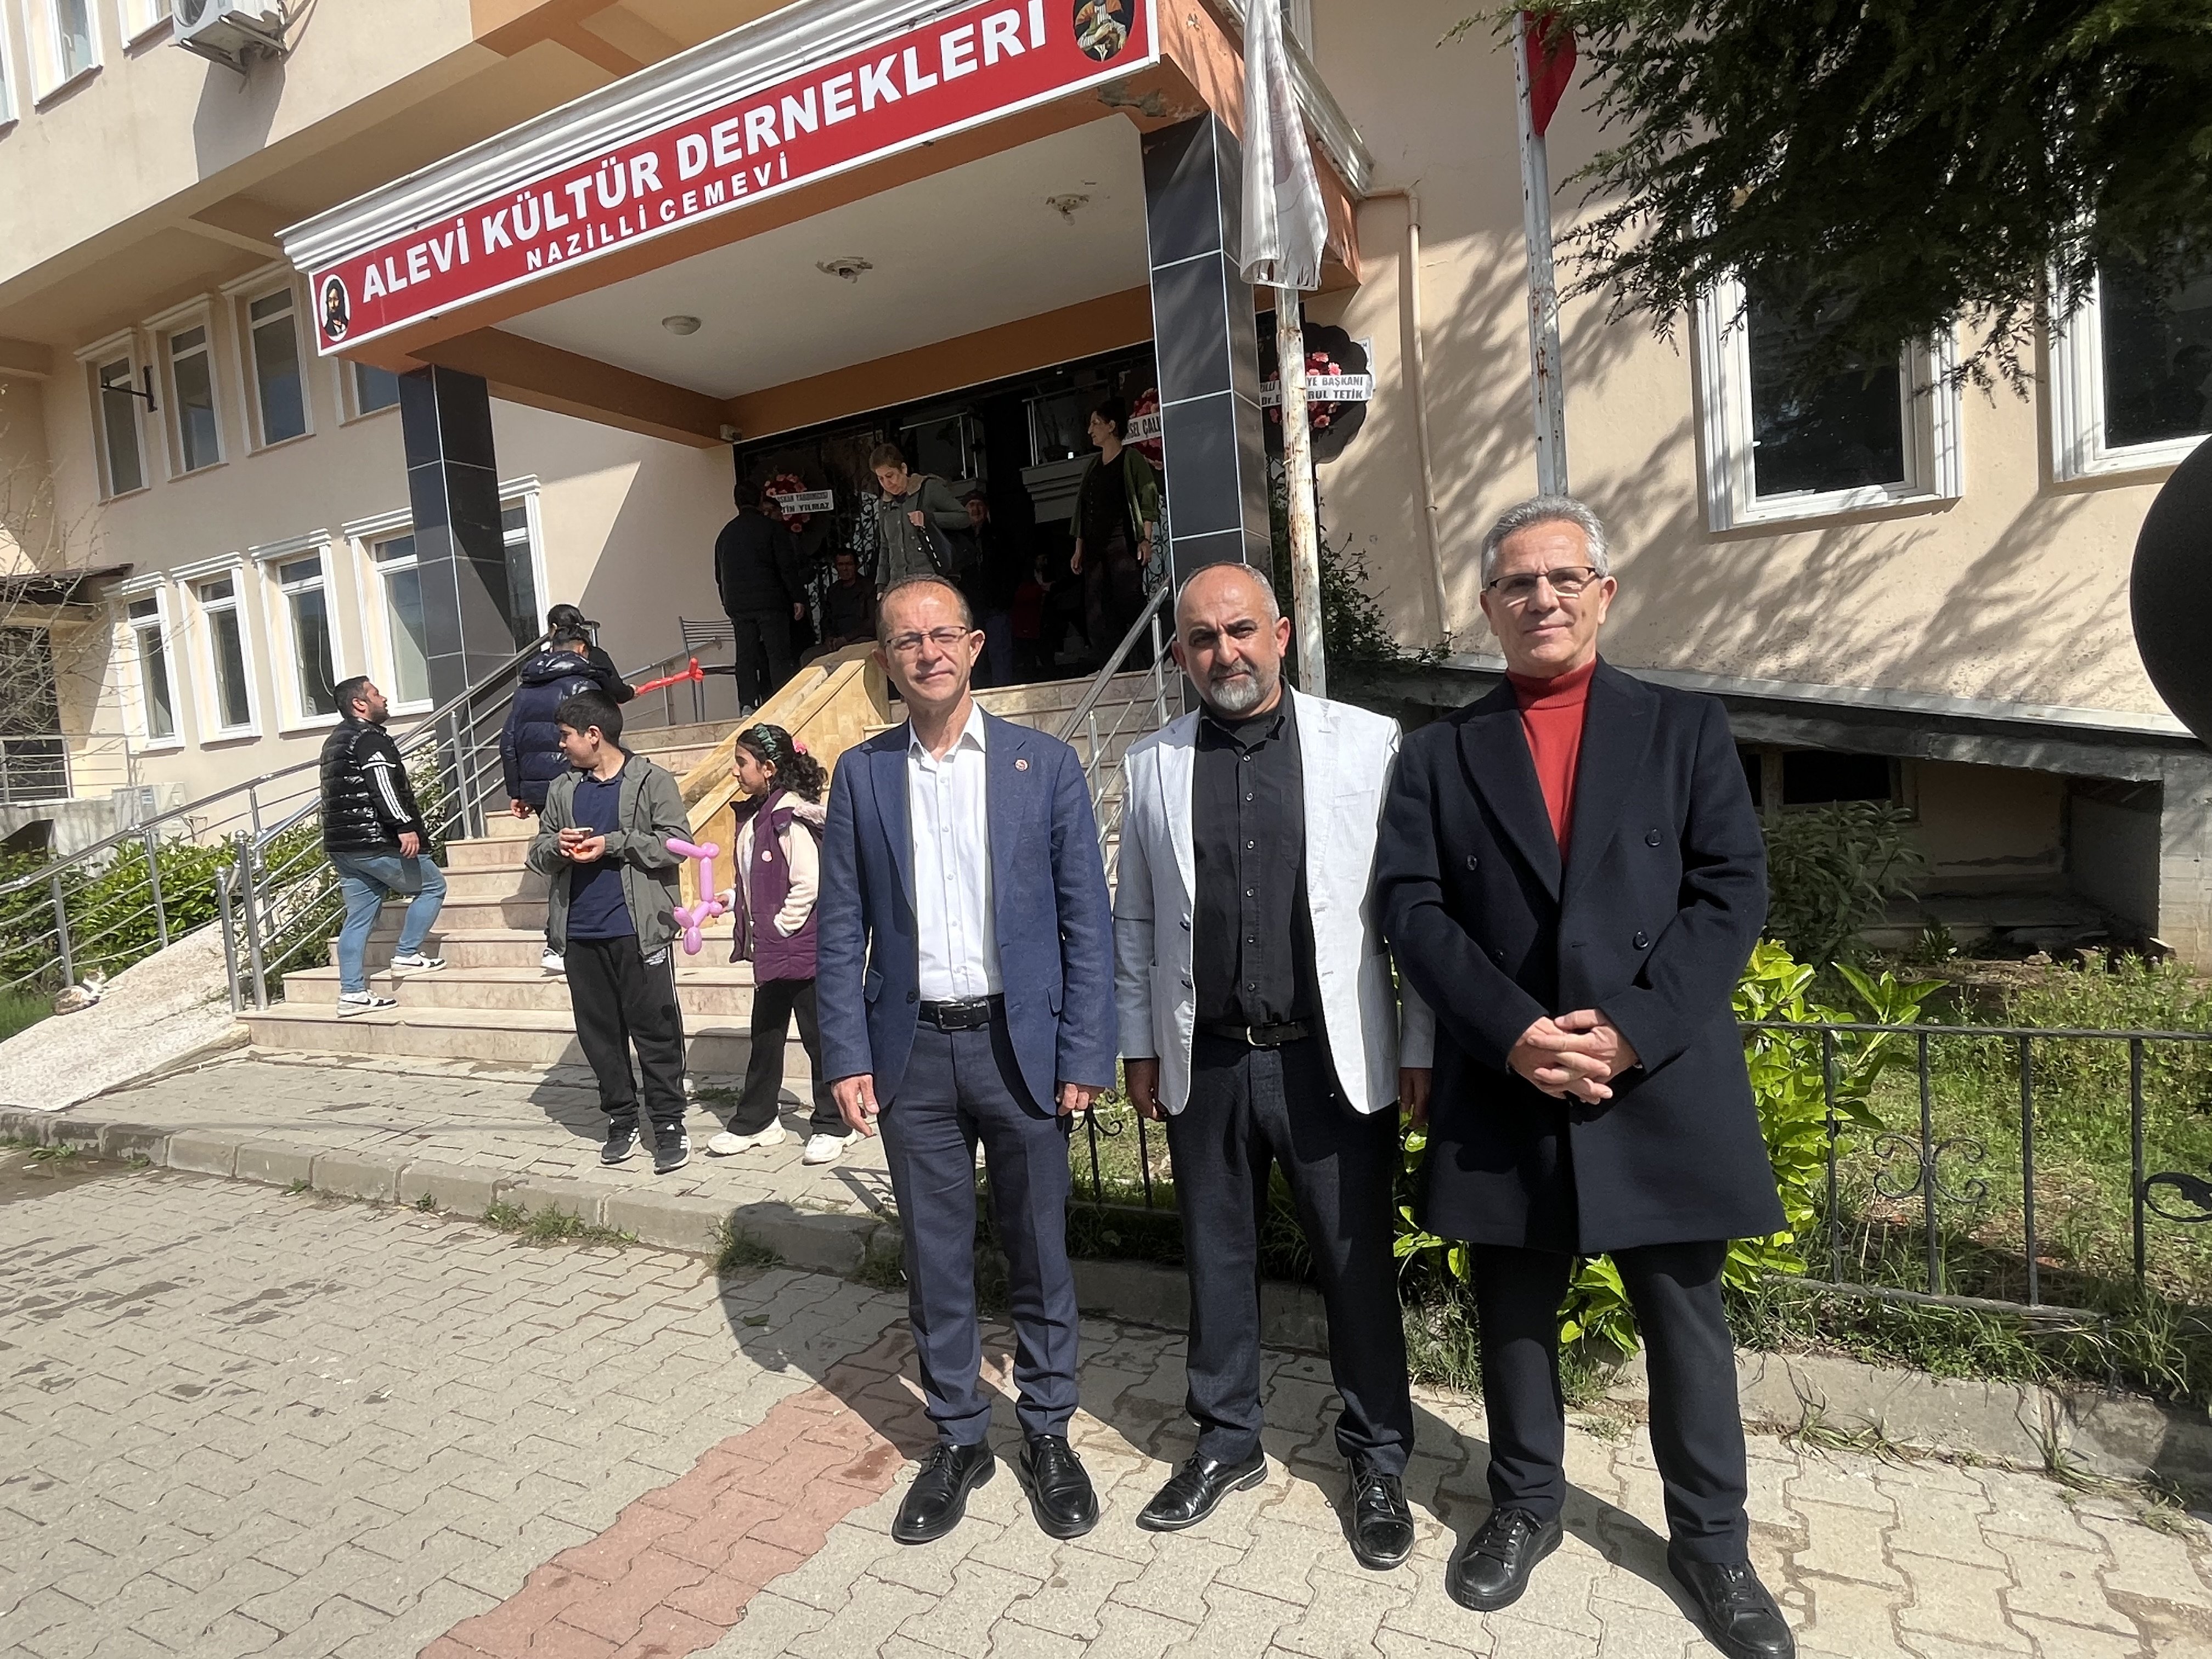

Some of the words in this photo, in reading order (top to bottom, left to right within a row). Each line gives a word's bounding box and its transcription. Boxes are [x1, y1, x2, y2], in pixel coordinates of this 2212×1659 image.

[363, 217, 470, 303] ALEVİ
[482, 151, 663, 255] KÜLTÜR
[527, 204, 646, 271] NAZİLLİ
[659, 152, 788, 222] CEMEVİ
[1308, 391, 1328, 399] RUL
[1334, 390, 1363, 399] TETİK
[1322, 376, 1363, 387] BAŞKANI
